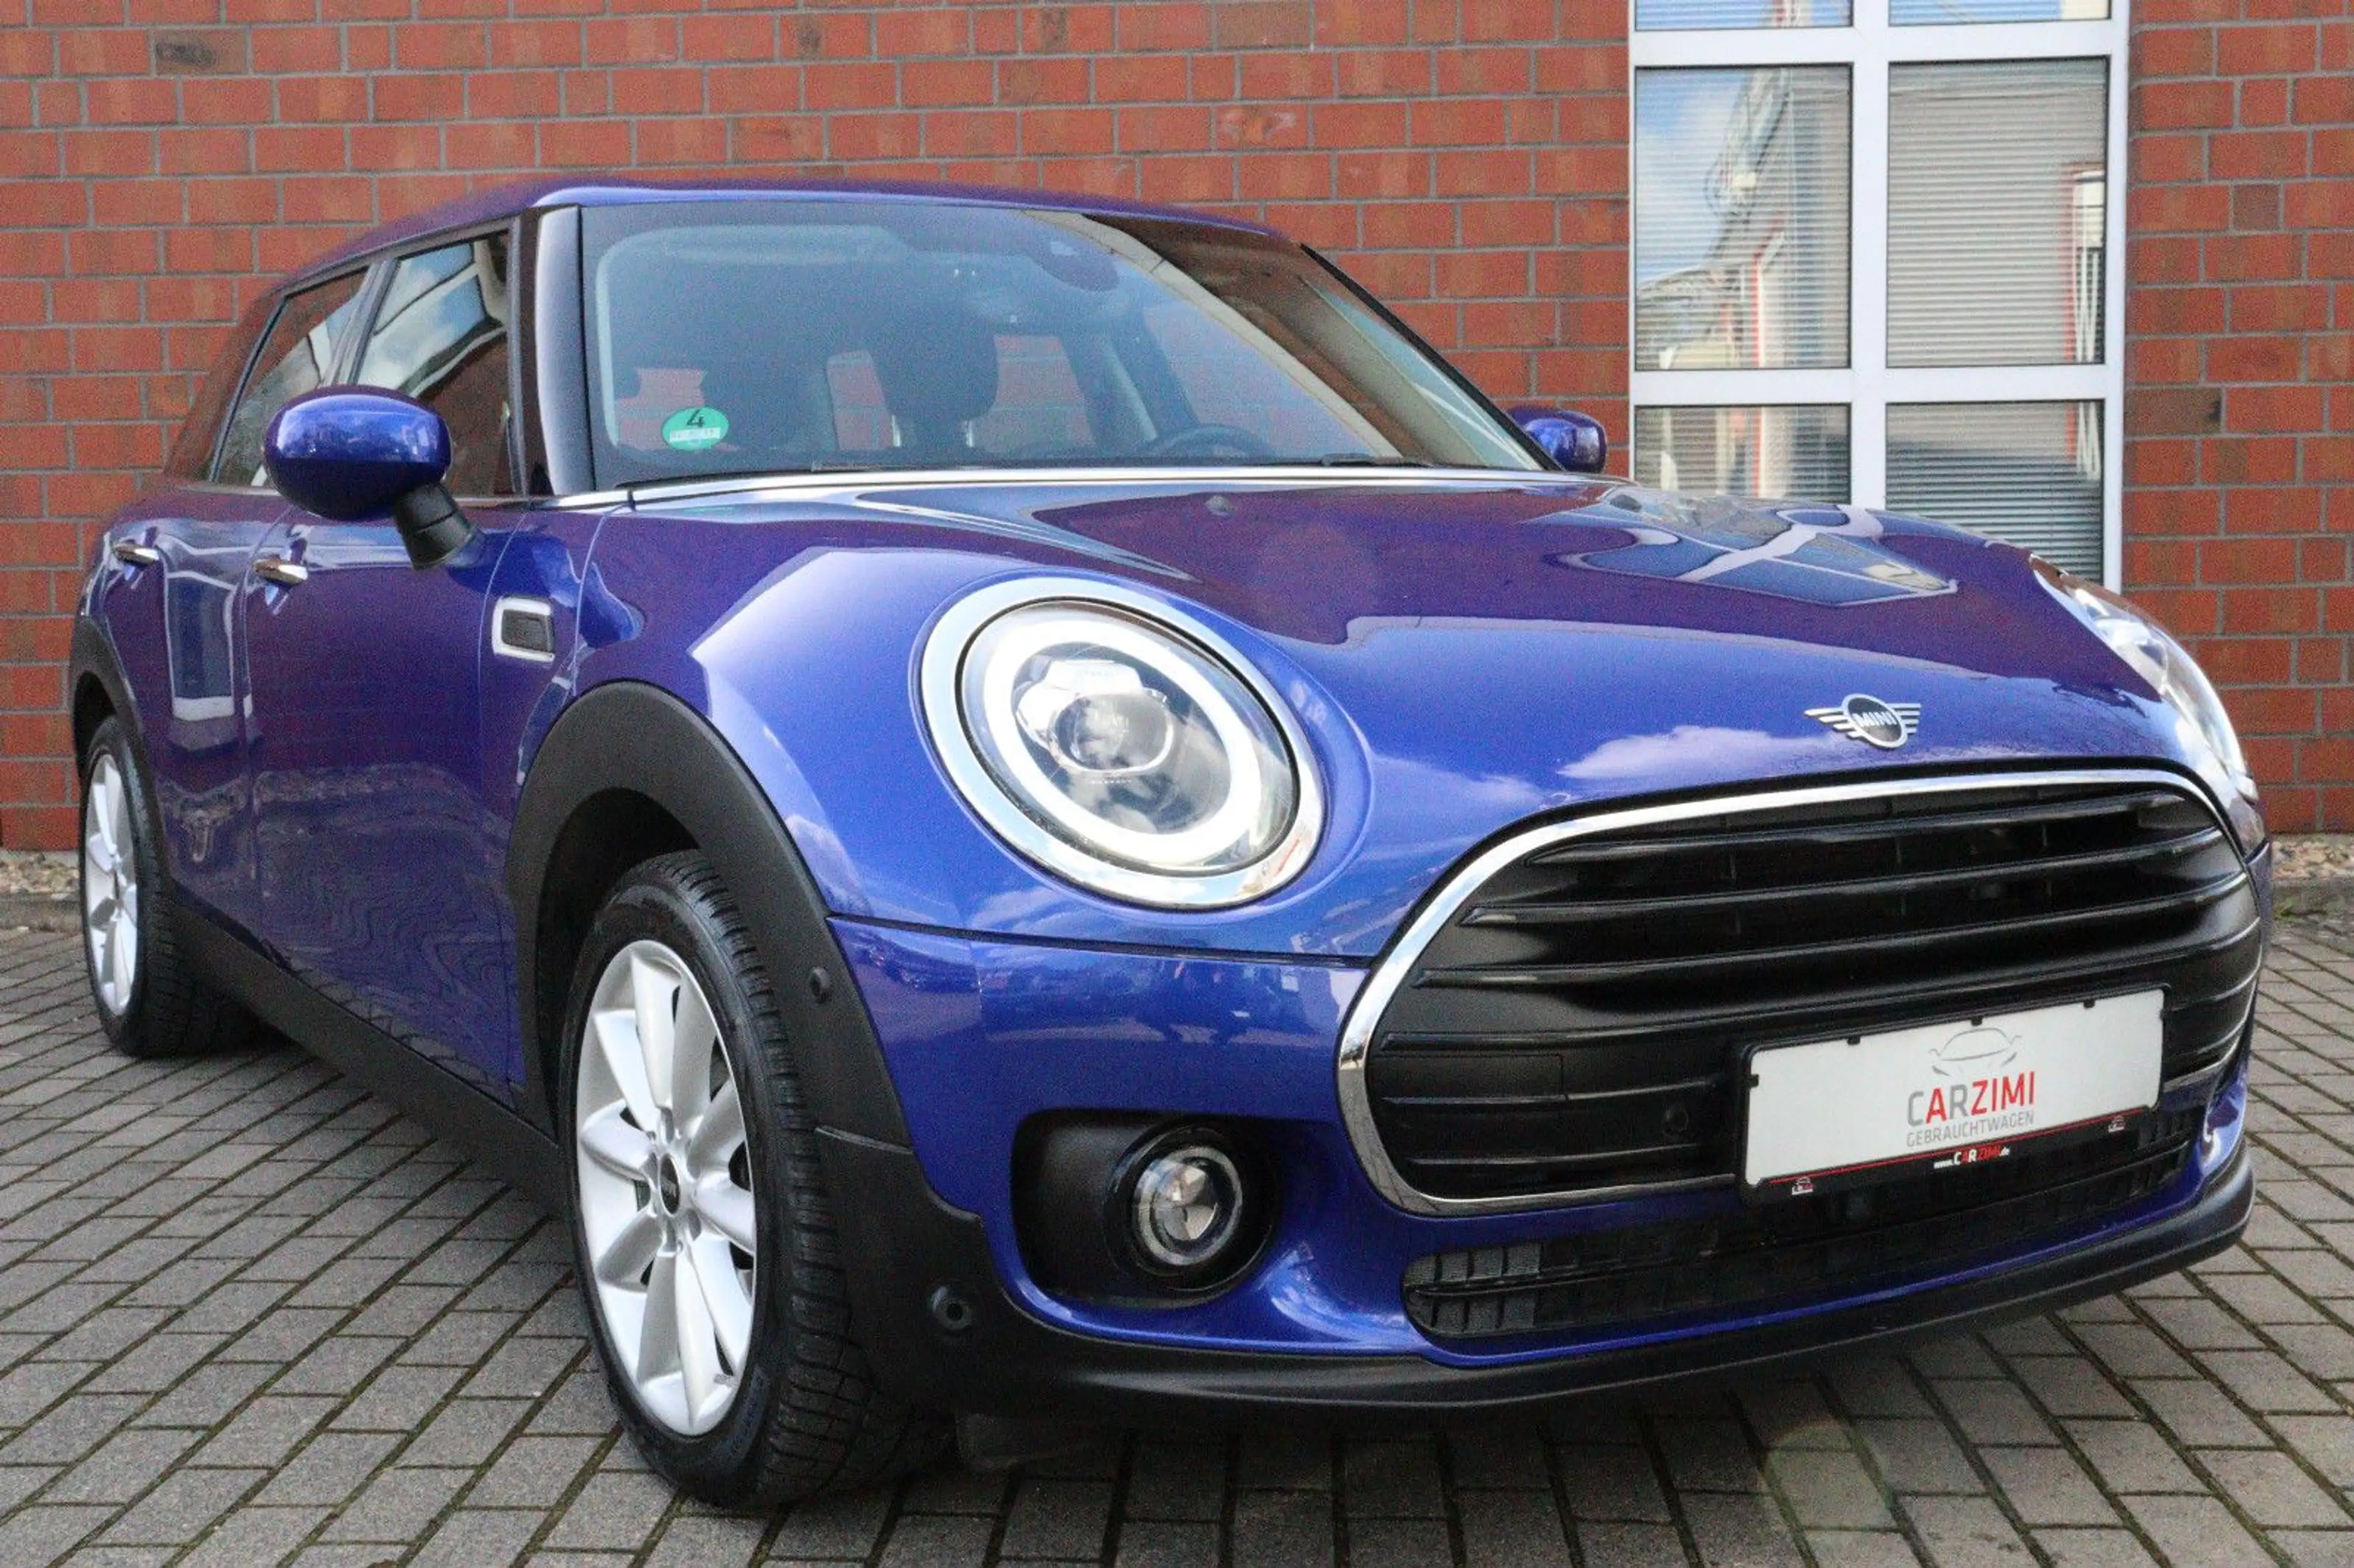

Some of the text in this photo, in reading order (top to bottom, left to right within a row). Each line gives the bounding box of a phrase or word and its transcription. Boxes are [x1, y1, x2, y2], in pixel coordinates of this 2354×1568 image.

[686, 409, 704, 428] 4
[1852, 711, 1897, 728] MINI
[1907, 1071, 2035, 1127] CARZIMI
[1906, 1109, 2035, 1147] GEBRAUCHTWAGEN
